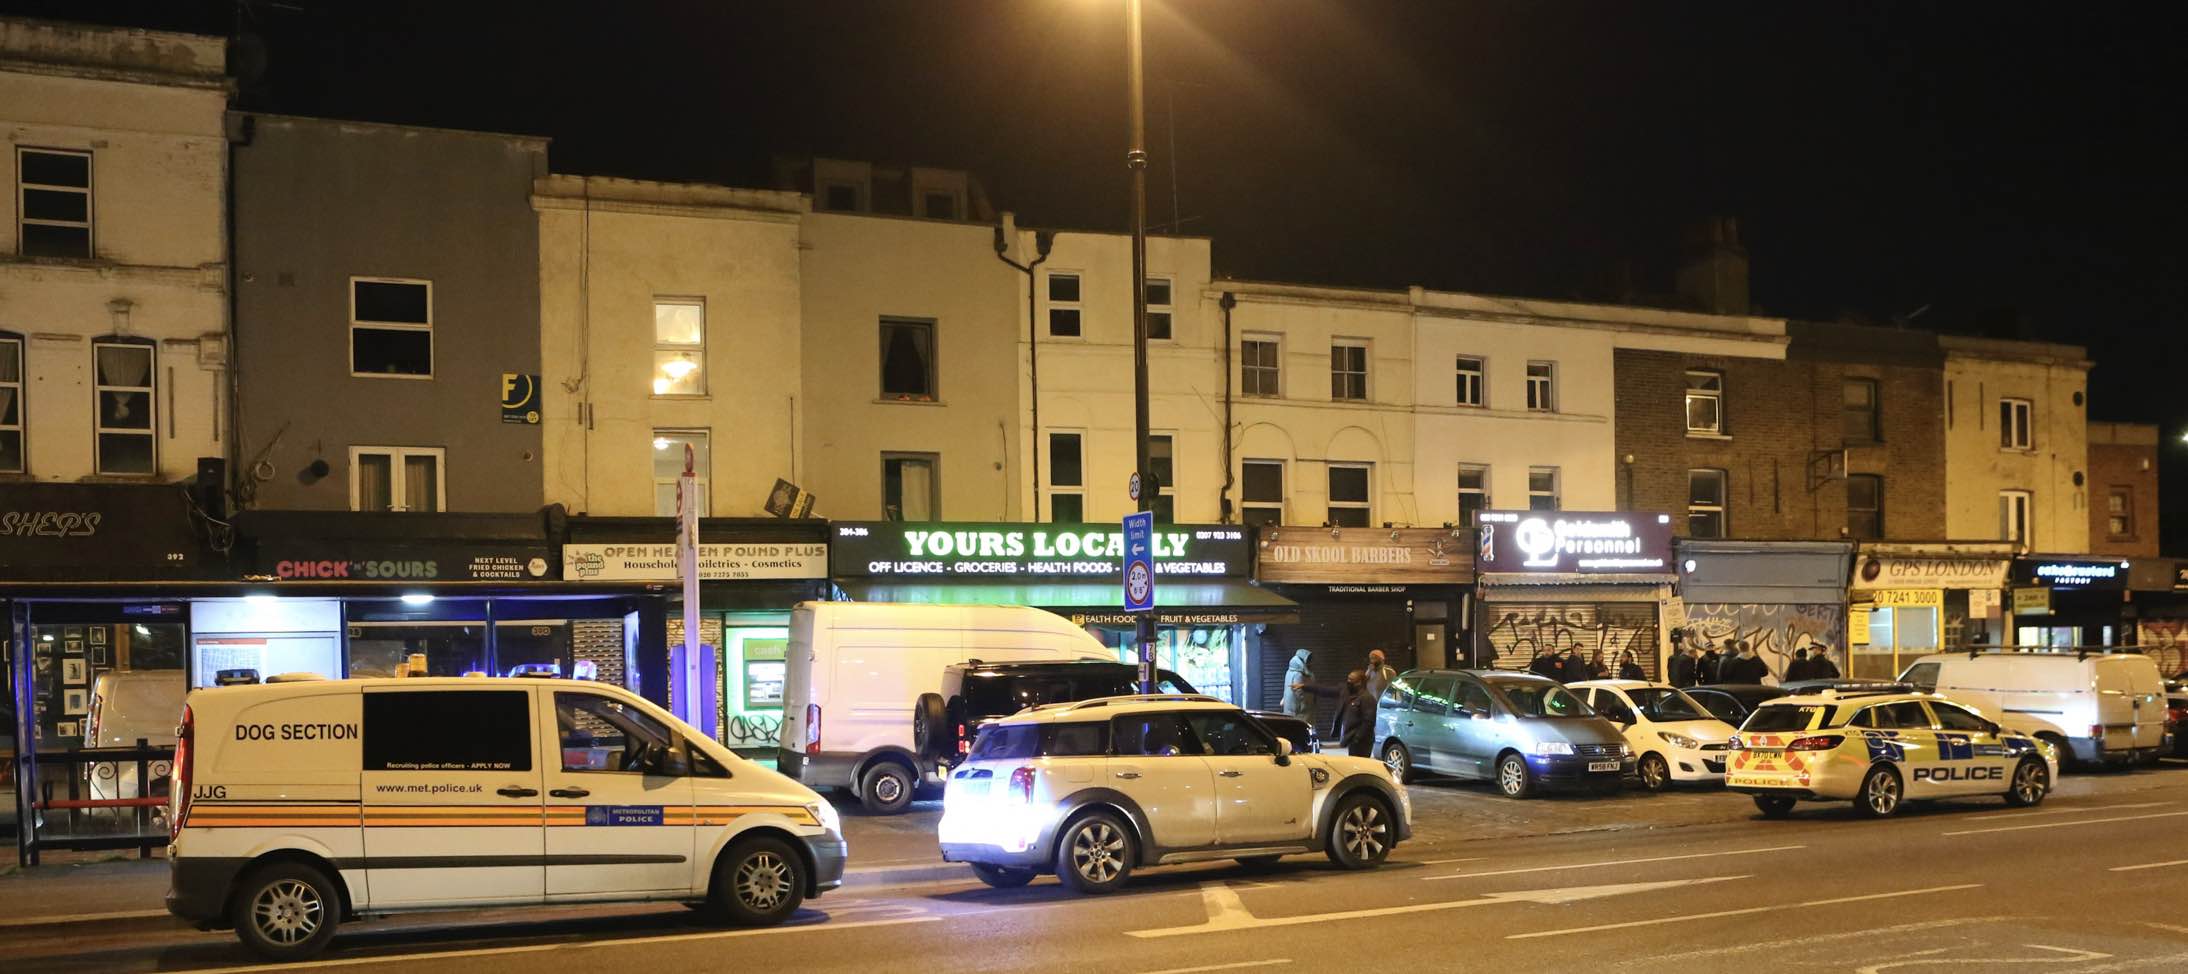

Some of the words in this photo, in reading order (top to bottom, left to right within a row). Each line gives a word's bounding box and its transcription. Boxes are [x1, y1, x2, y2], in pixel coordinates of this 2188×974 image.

[1131, 481, 1139, 493] 20
[0, 512, 101, 537] SHEP'S
[1129, 519, 1145, 529] Width
[1131, 530, 1144, 540] limit
[904, 531, 1023, 556] YOURS
[1033, 532, 1189, 557] LOCALY
[1555, 537, 1640, 554] Personnel
[604, 547, 647, 558] OPEN
[723, 547, 779, 557] POUND
[785, 547, 825, 557] PLUS
[1274, 546, 1300, 563] OLD
[1304, 546, 1347, 563] SKOOL
[1352, 547, 1412, 564] BARBERS
[276, 560, 349, 577] CHICK
[366, 560, 437, 577] SOURS
[699, 560, 741, 568] oiletries
[752, 560, 802, 569] Cosmetics
[868, 561, 891, 573] OFF
[894, 561, 943, 573] LICENCE
[955, 561, 1016, 573] GROCERIES
[1028, 562, 1070, 573] HEALTH
[1073, 562, 1113, 574] FOODS
[1889, 561, 1921, 577] GPS
[1924, 561, 1995, 577] LONDON
[1888, 592, 1910, 603] 7241
[1915, 592, 1937, 603] 3000
[1085, 615, 1111, 623] EALTH
[1113, 615, 1137, 623] FOOD
[1161, 615, 1182, 623] FRUIT
[235, 725, 275, 740] DOG
[281, 724, 358, 740] SECTION
[1913, 767, 2003, 782] POLICE
[194, 786, 227, 798] JJG
[376, 784, 482, 794] www.met.police.uk
